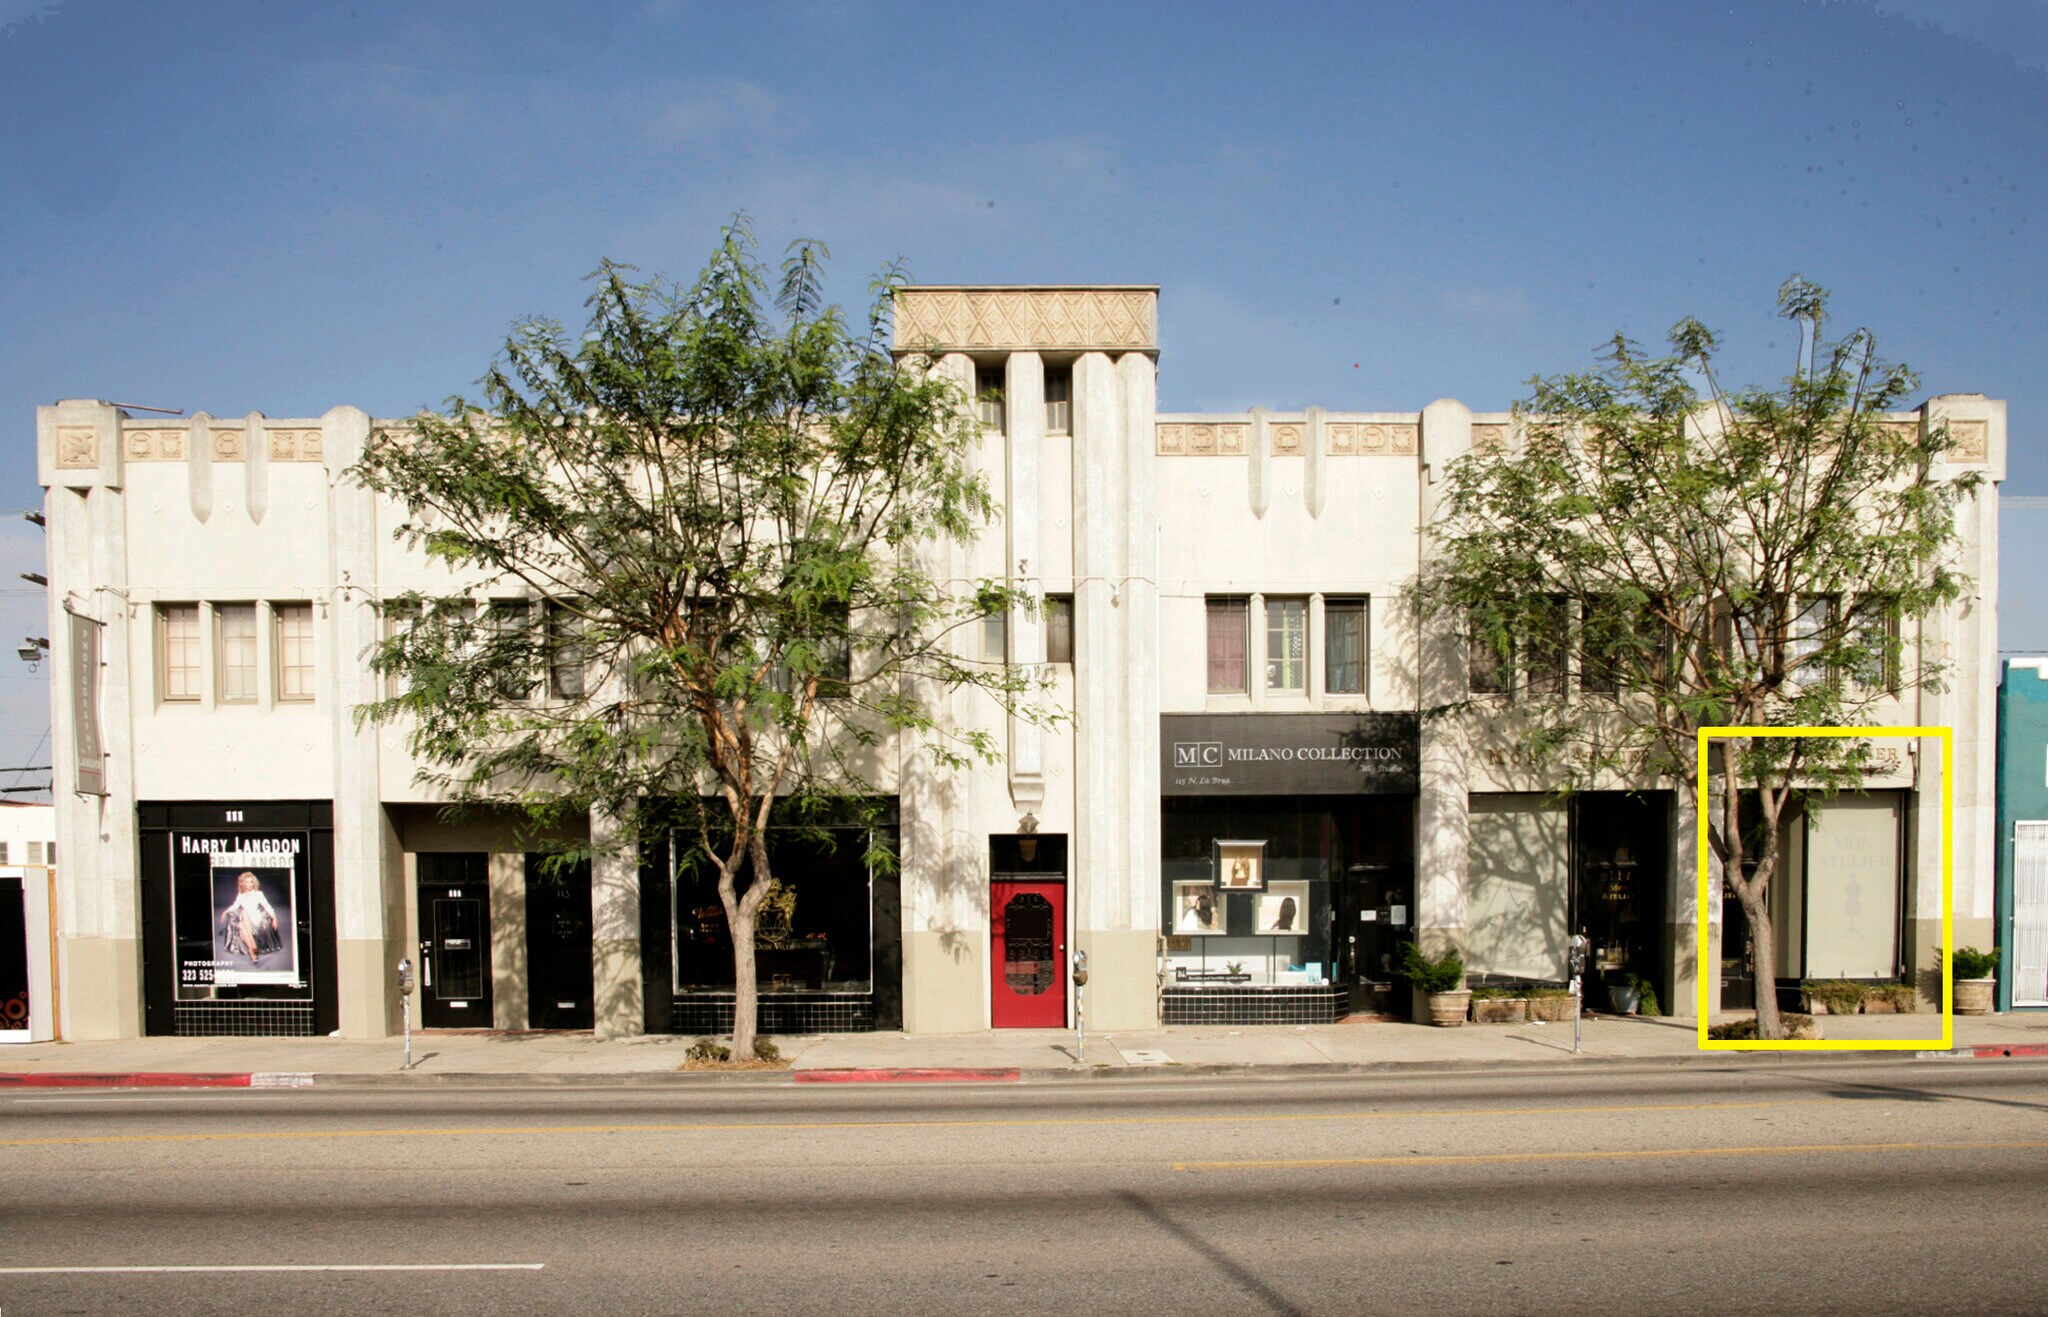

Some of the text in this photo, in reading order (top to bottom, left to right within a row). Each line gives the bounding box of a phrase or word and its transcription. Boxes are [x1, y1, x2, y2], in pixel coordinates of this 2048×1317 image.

[82, 629, 92, 754] PHOTOGRAPHY
[1228, 747, 1293, 762] MILANO
[1297, 747, 1402, 762] COLLECTION
[1175, 778, 1186, 786] 115
[1199, 777, 1210, 785] La
[1212, 777, 1230, 785] Brea
[226, 811, 243, 822] 111
[182, 836, 300, 853] HARRY LANGDON
[1834, 836, 1873, 851] MON
[1818, 854, 1891, 868] ATELIER
[449, 889, 462, 898] 111
[182, 969, 197, 981] 323
